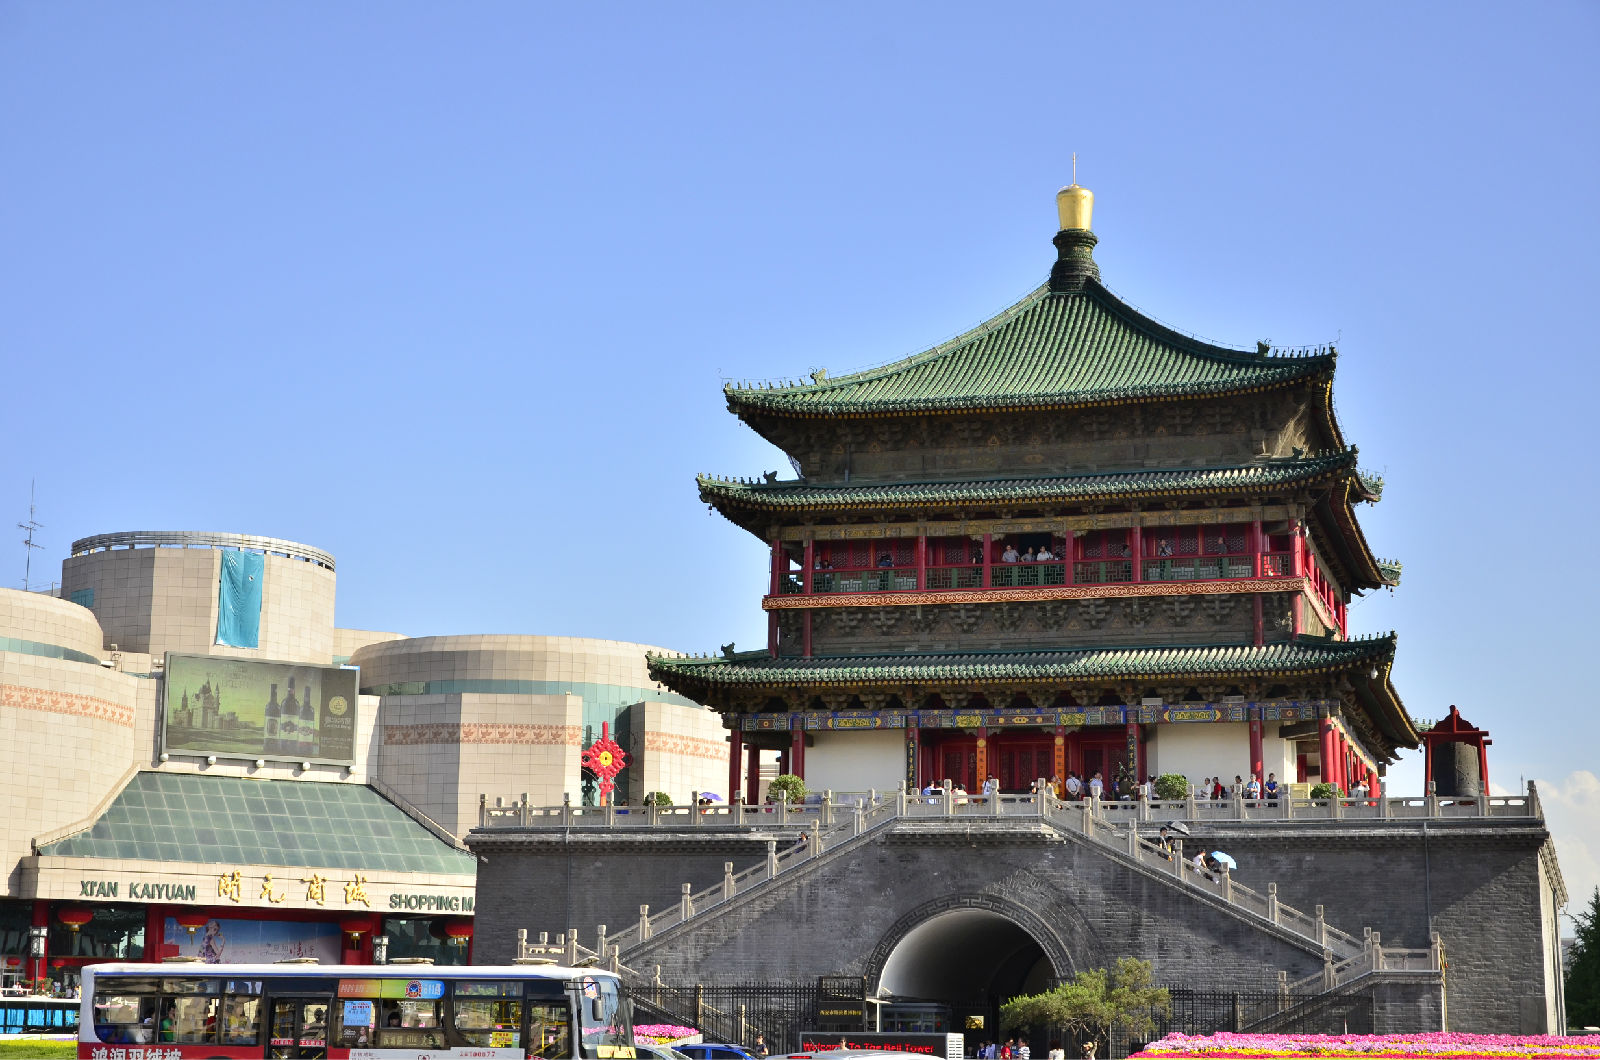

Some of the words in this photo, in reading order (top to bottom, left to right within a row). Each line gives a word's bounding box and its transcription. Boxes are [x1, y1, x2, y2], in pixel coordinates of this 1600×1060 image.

[79, 880, 118, 898] XI'AN
[129, 882, 196, 901] KAIYUAN
[389, 893, 459, 912] SHOPPING
[461, 896, 476, 912] M
[905, 1044, 934, 1054] Tower
